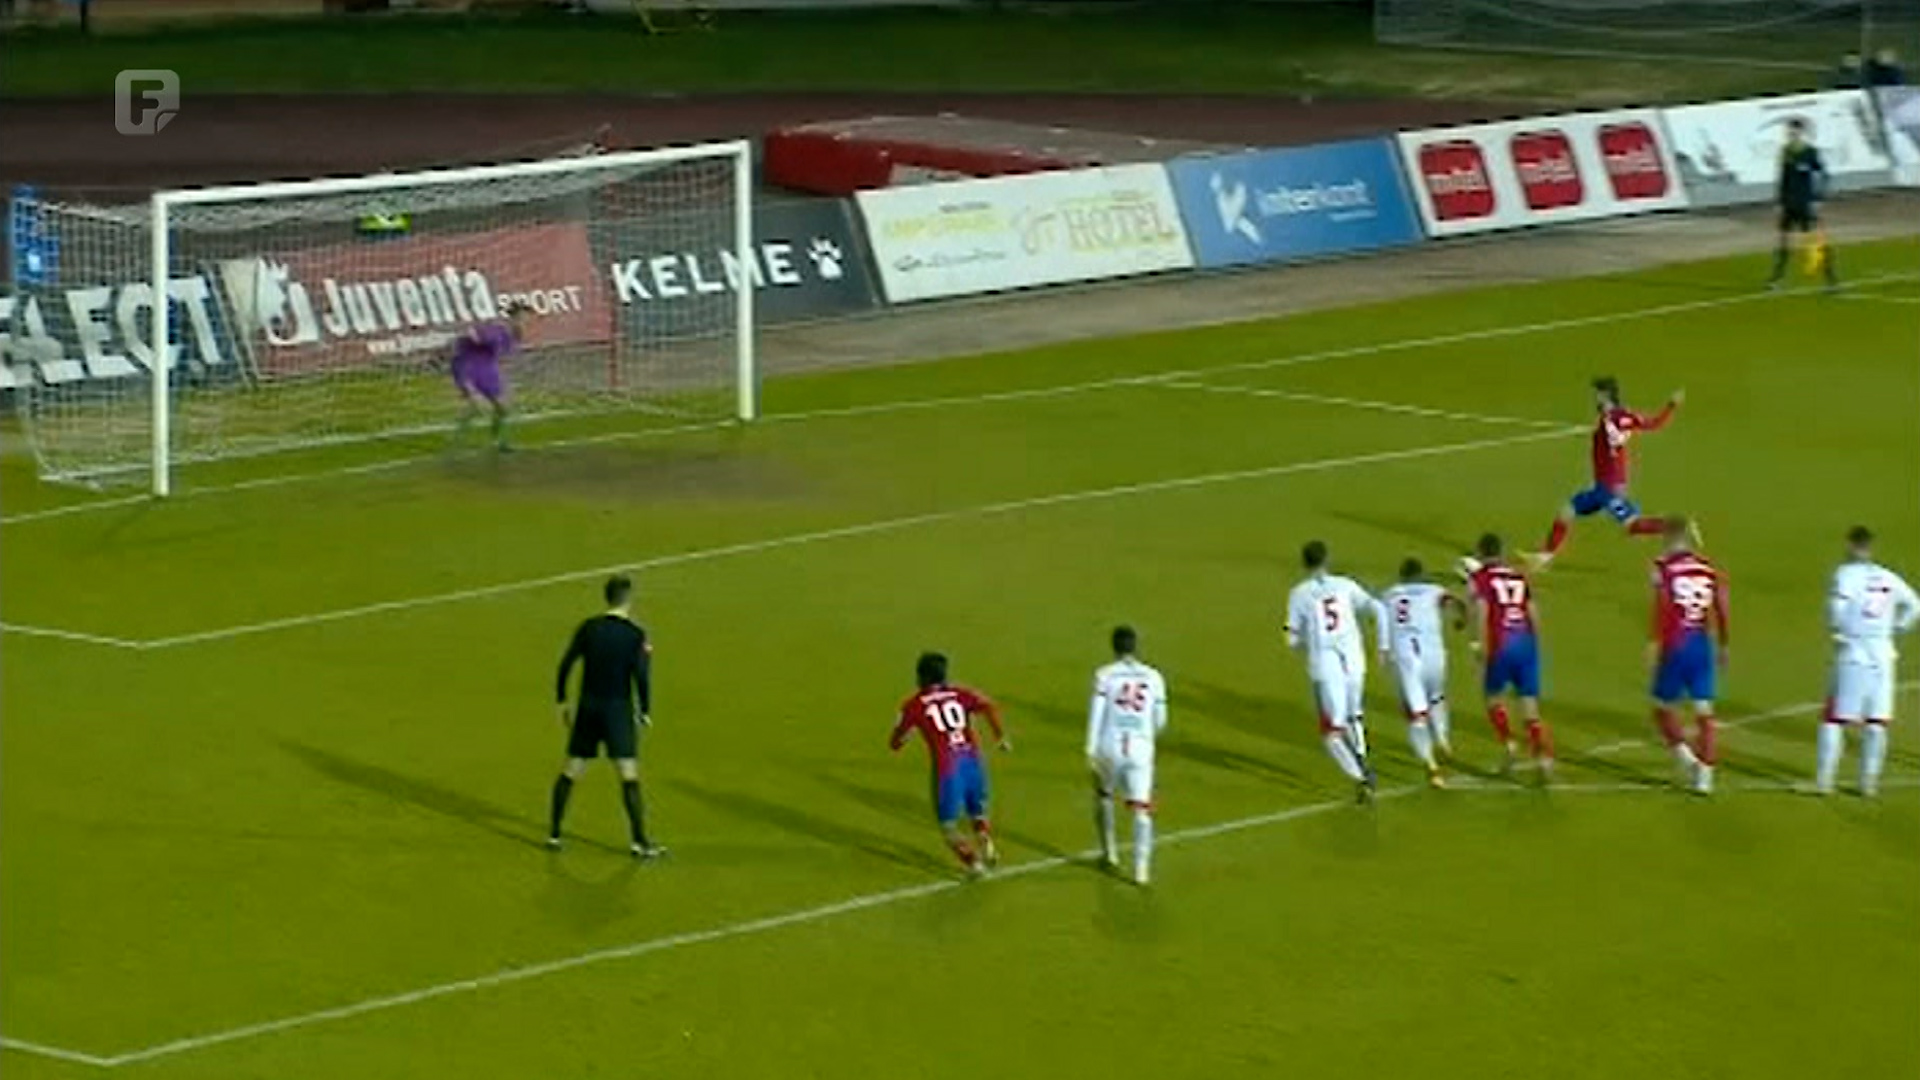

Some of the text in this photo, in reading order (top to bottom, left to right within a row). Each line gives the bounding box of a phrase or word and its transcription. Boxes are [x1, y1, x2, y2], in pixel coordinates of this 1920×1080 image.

[1063, 203, 1176, 250] HOTEL
[612, 243, 801, 303] KELME
[323, 266, 497, 337] Juventa
[1491, 577, 1525, 604] 17
[1322, 596, 1339, 631] 5
[925, 699, 966, 733] 10
